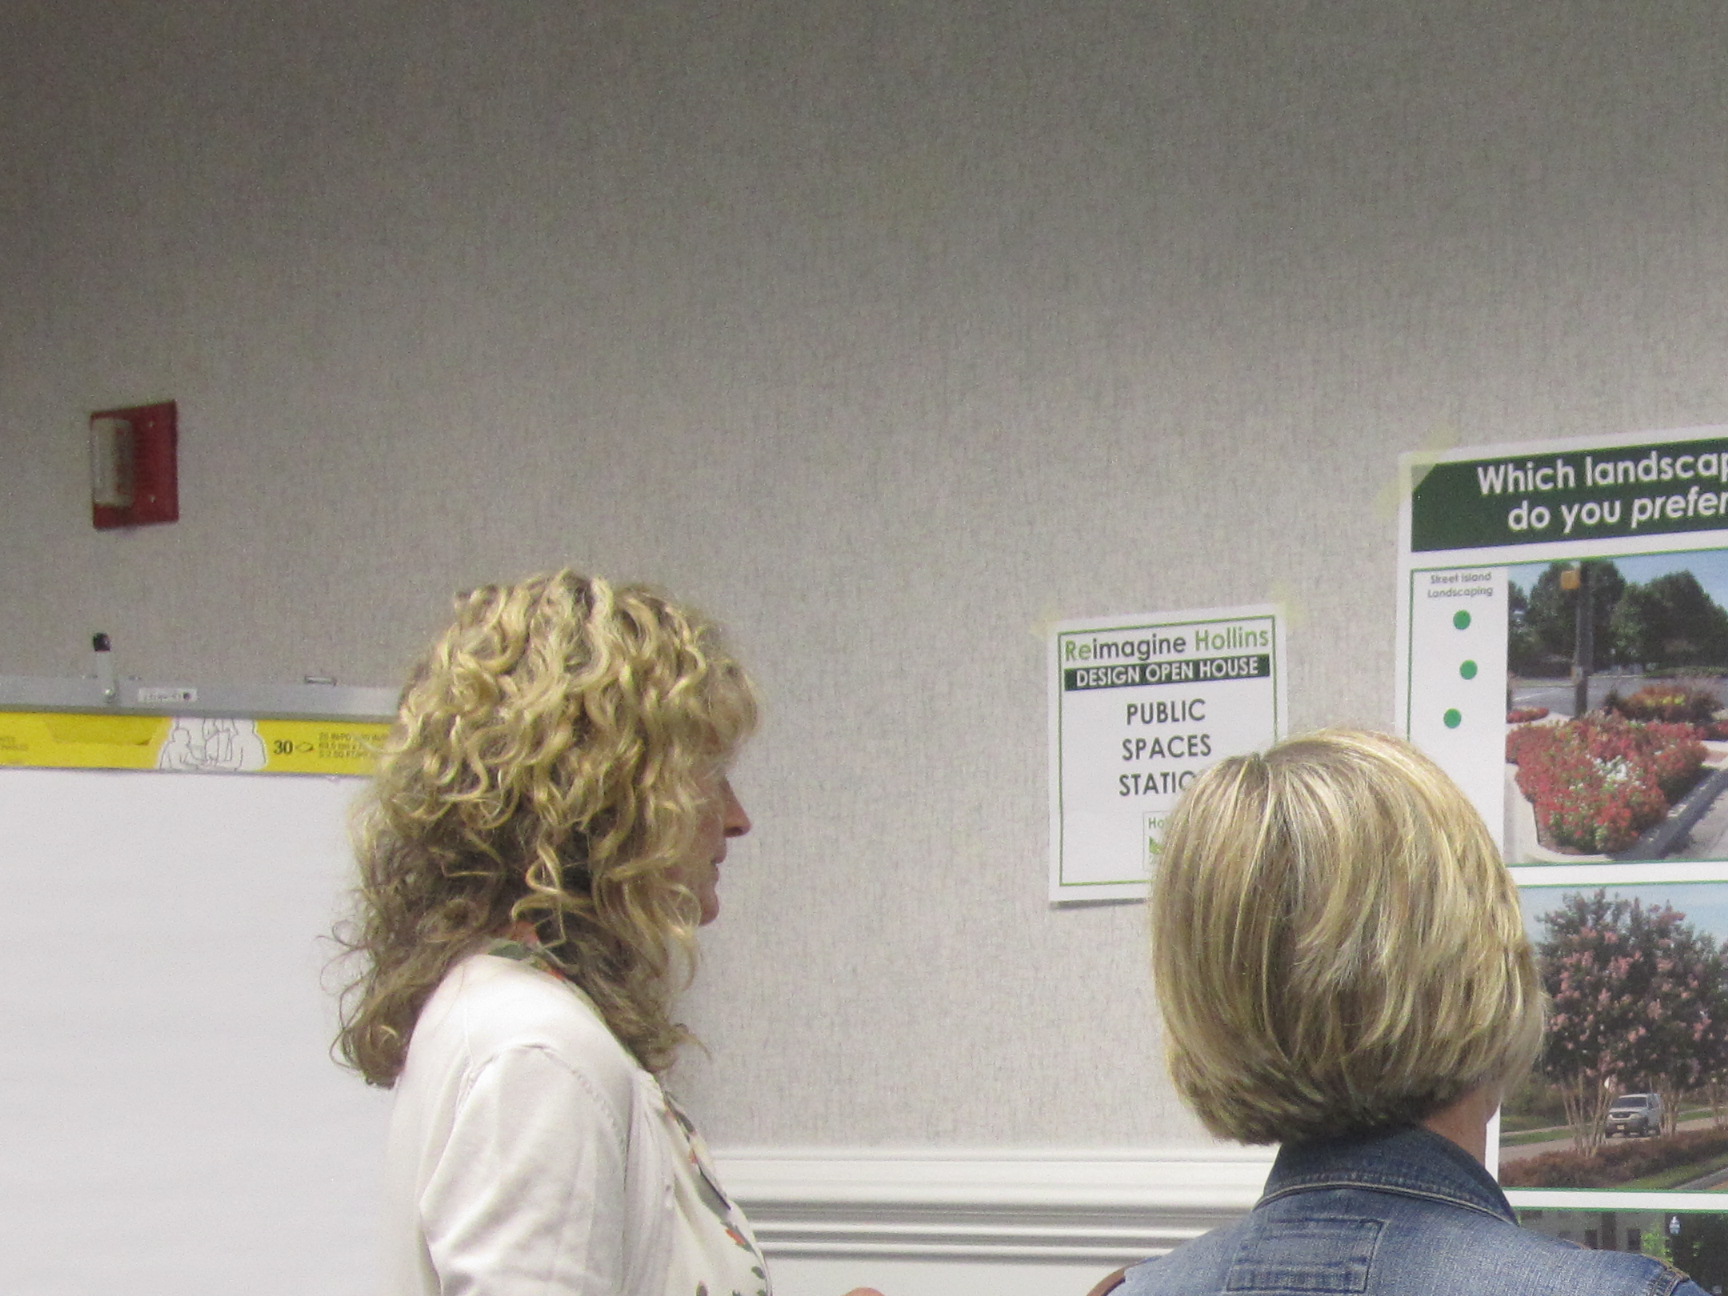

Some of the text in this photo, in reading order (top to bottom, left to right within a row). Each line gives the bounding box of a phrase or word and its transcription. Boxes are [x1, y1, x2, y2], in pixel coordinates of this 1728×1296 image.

[1477, 461, 1575, 496] Which
[1508, 501, 1551, 531] do
[1560, 500, 1621, 534] you
[1427, 586, 1494, 598] Landscaping
[1430, 574, 1459, 584] Street
[1065, 626, 1269, 662] Reimagine Hollins
[1076, 656, 1259, 688] DESIGN OPEN HOUSE
[1126, 698, 1206, 726] PUBLIC
[273, 740, 294, 754] 30
[1122, 734, 1212, 761] SPACES
[1119, 770, 1197, 796] STATIO
